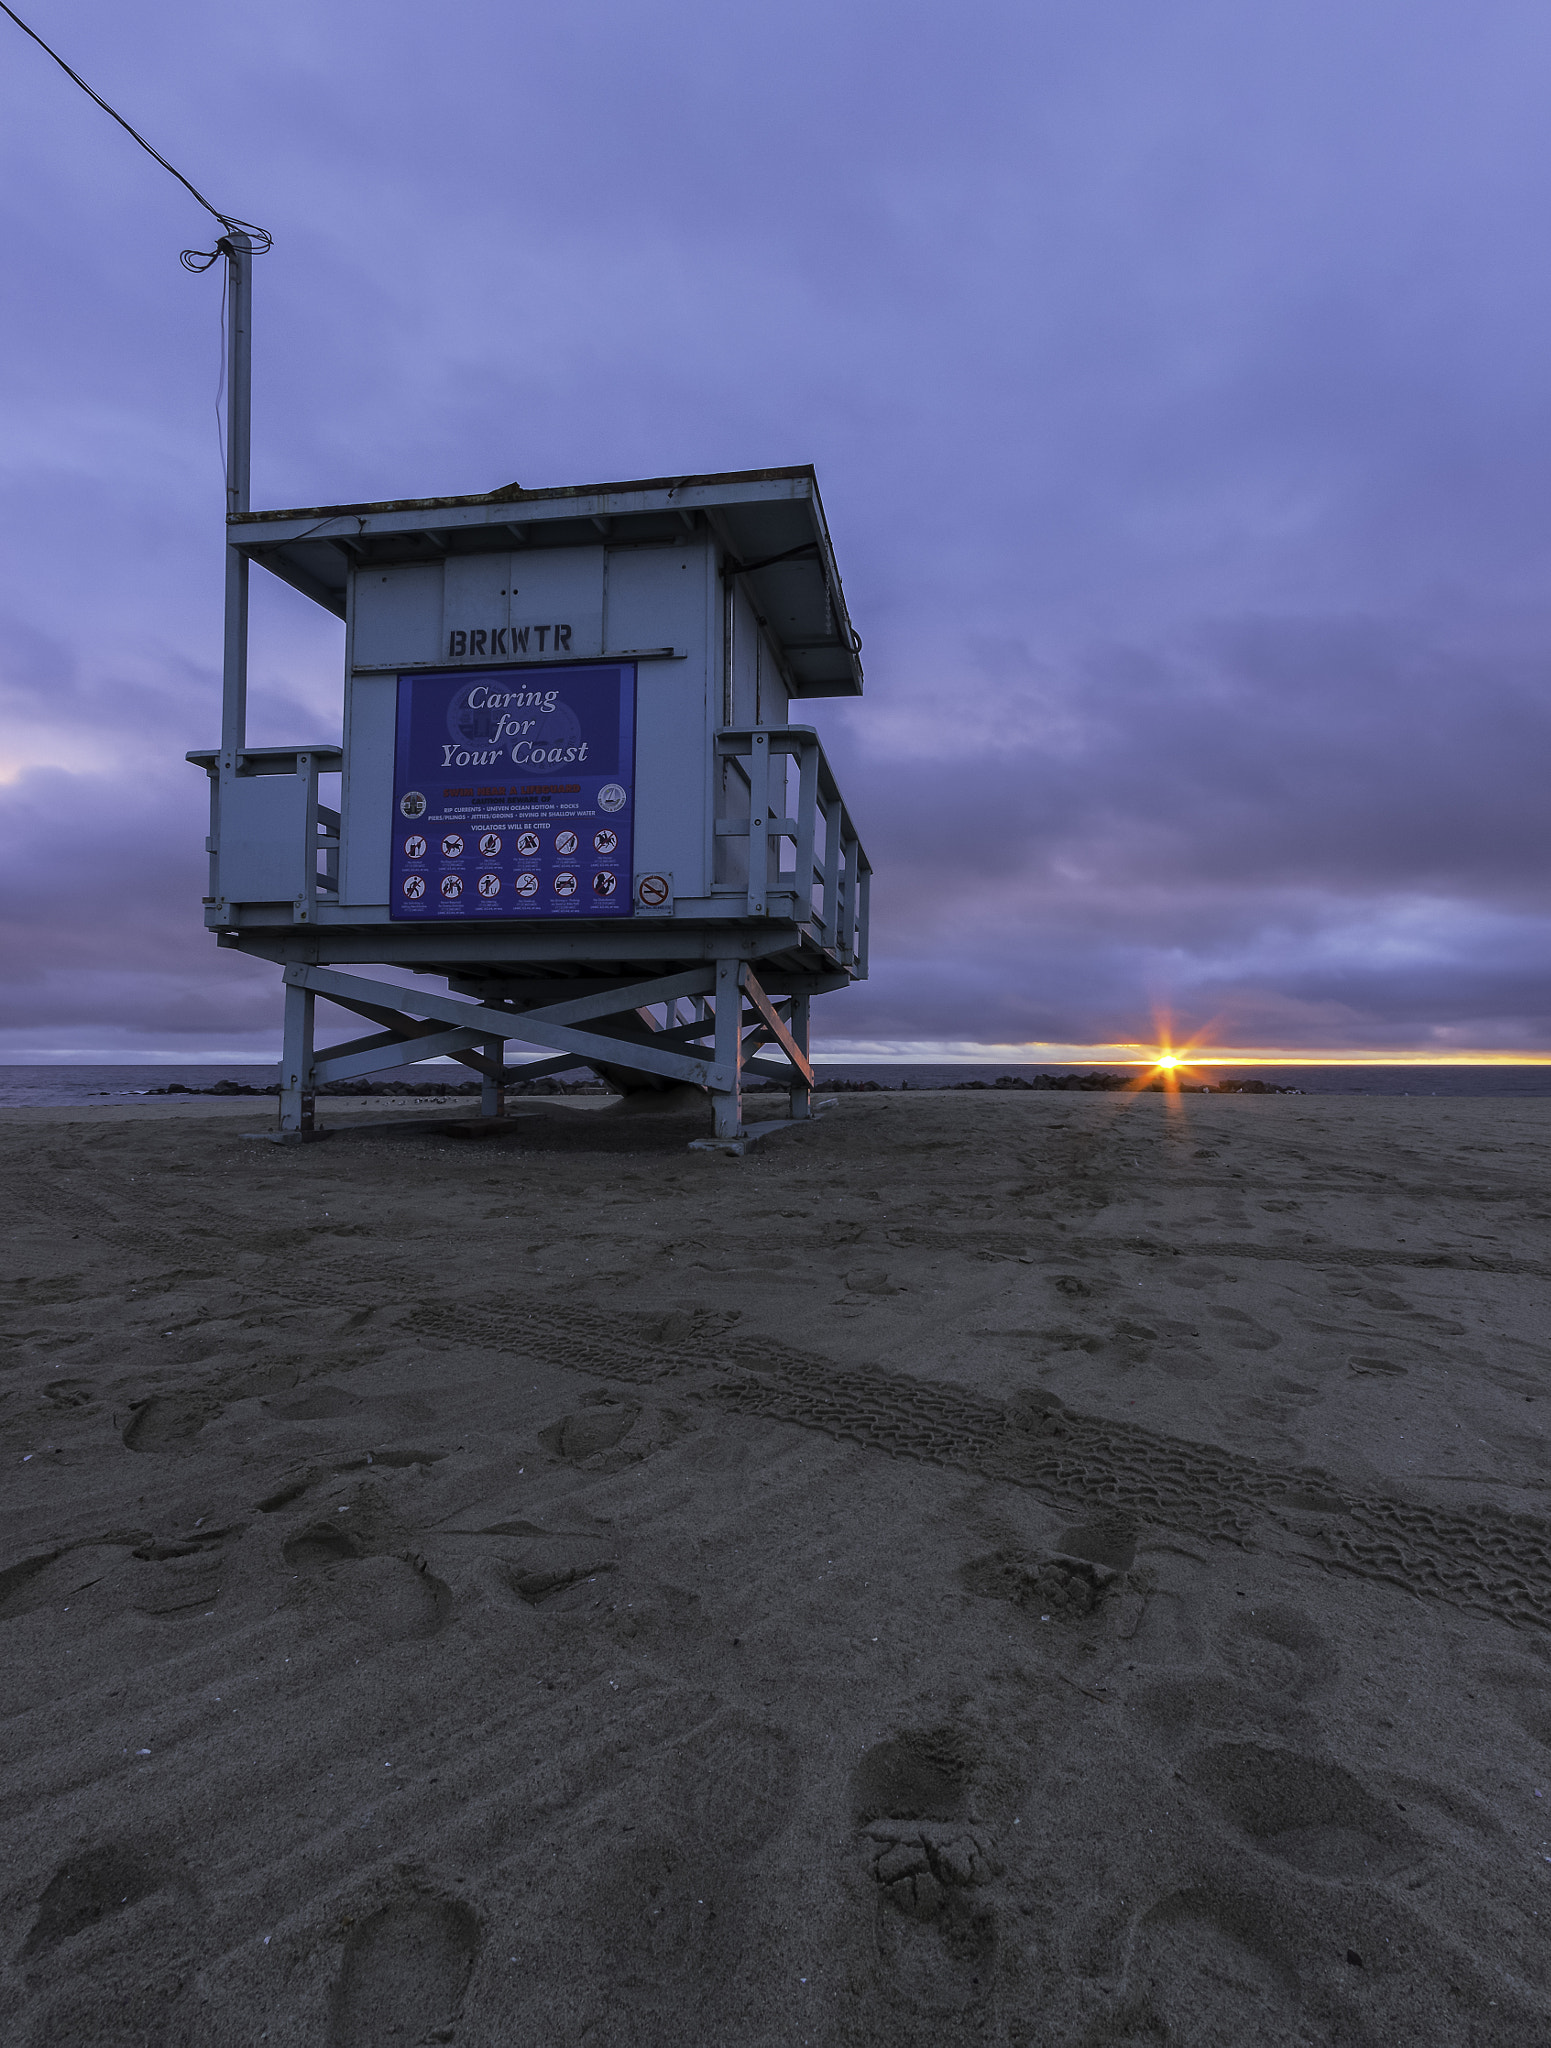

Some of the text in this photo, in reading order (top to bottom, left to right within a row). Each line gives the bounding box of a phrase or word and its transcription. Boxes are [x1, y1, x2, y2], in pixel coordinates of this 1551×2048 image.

[449, 624, 572, 656] BRKWTR
[468, 684, 559, 713] Caring
[488, 714, 535, 744] for
[441, 741, 589, 767] Your Coast
[443, 784, 581, 797] SWIM NEAR A LIFEGUARD
